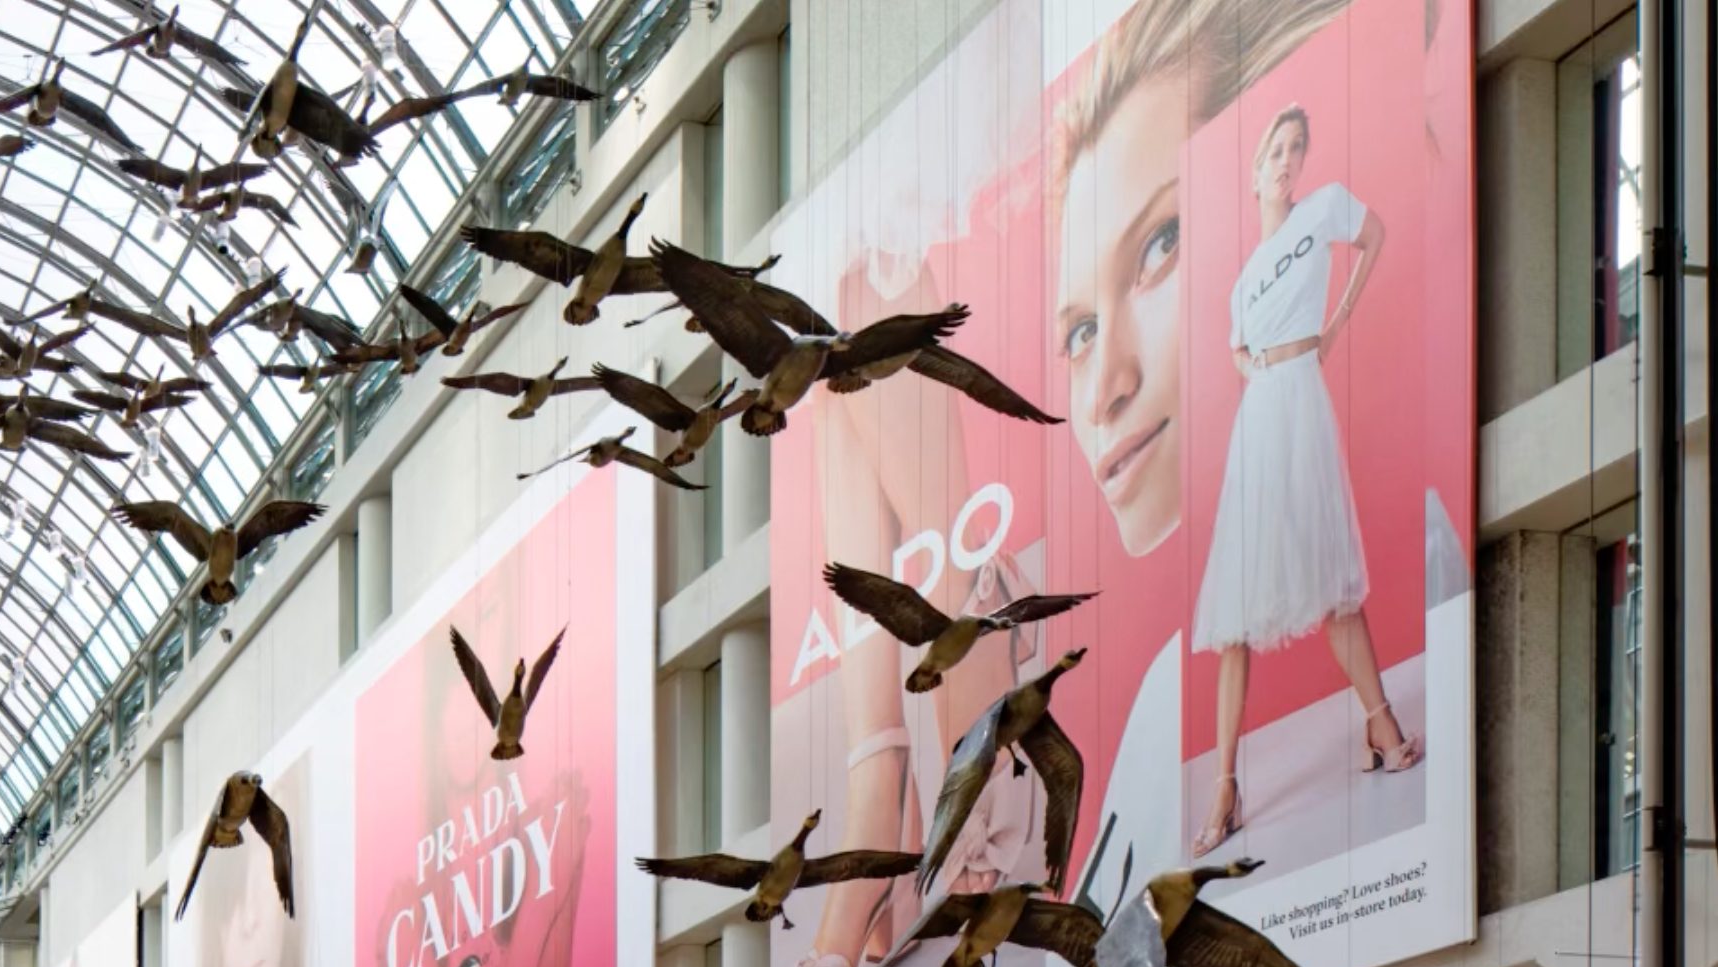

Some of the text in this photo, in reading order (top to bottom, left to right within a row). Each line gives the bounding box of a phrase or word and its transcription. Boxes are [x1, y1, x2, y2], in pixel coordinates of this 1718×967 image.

[416, 771, 528, 887] PRADA
[1260, 861, 1428, 931] Like shopping? Love shoes?
[1289, 886, 1428, 940] Visit us in-store today.
